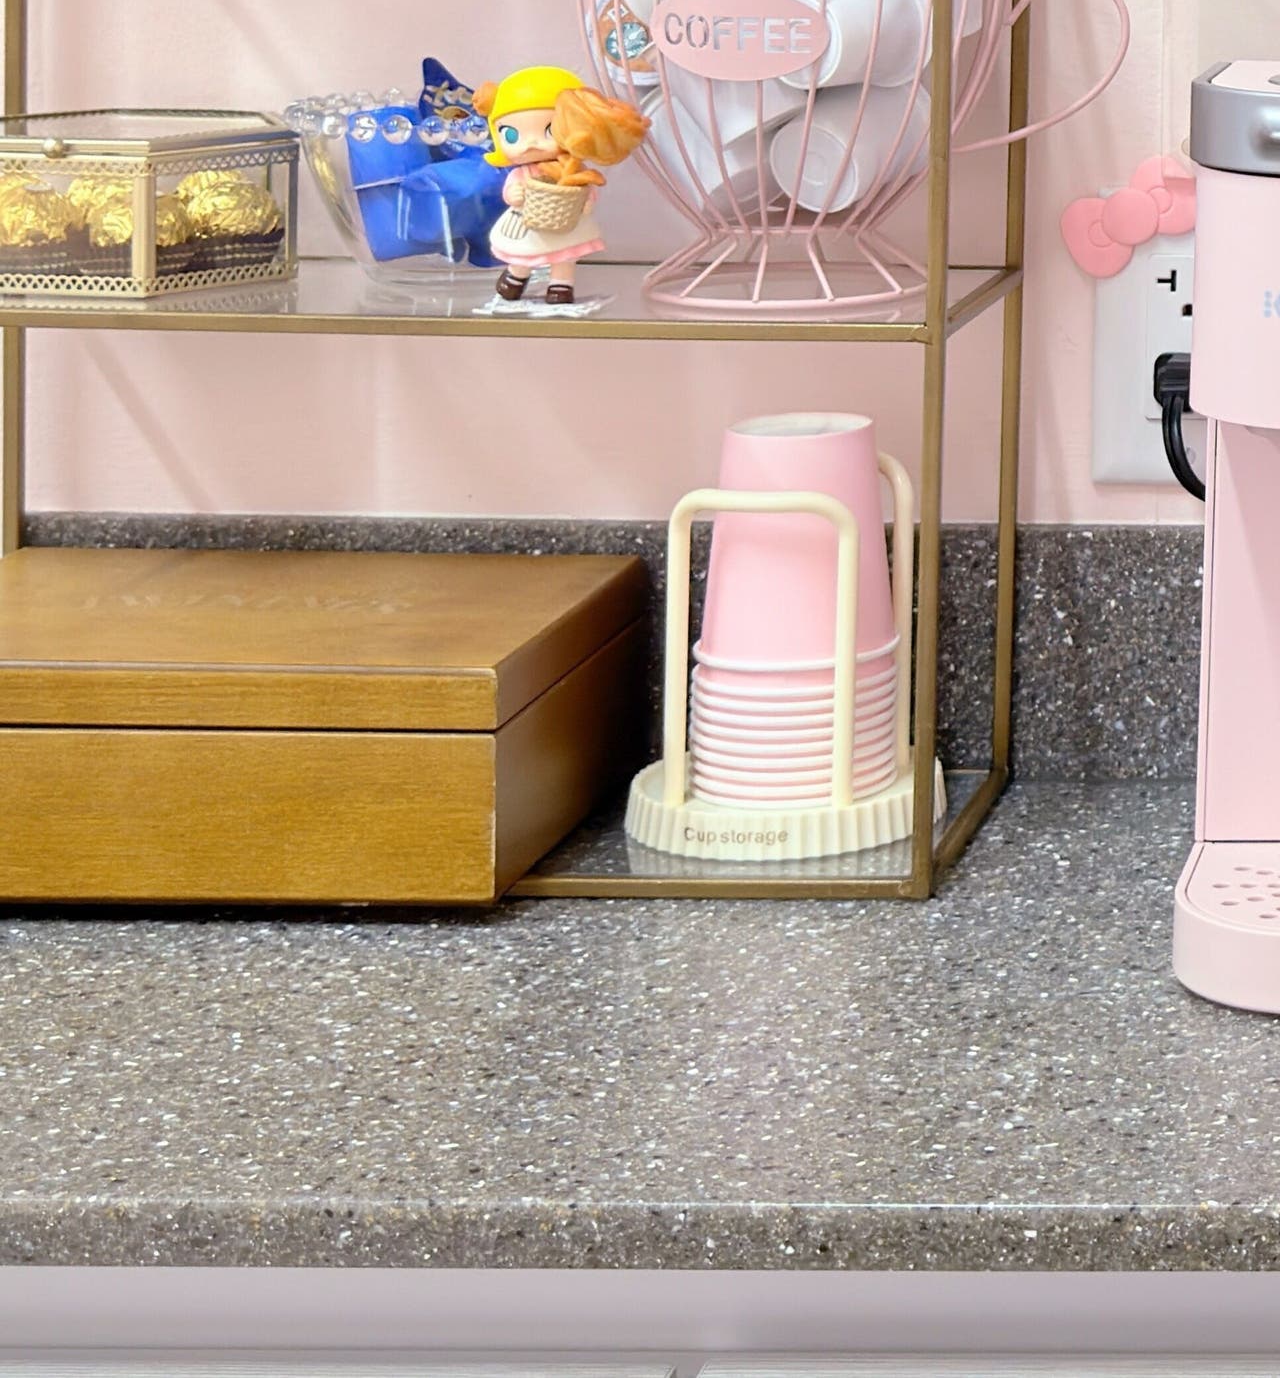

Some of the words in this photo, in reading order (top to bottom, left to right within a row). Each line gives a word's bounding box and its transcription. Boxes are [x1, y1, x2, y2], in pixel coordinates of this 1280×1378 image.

[663, 12, 813, 54] COFFEE
[684, 827, 716, 844] Cup
[720, 829, 788, 846] storage
